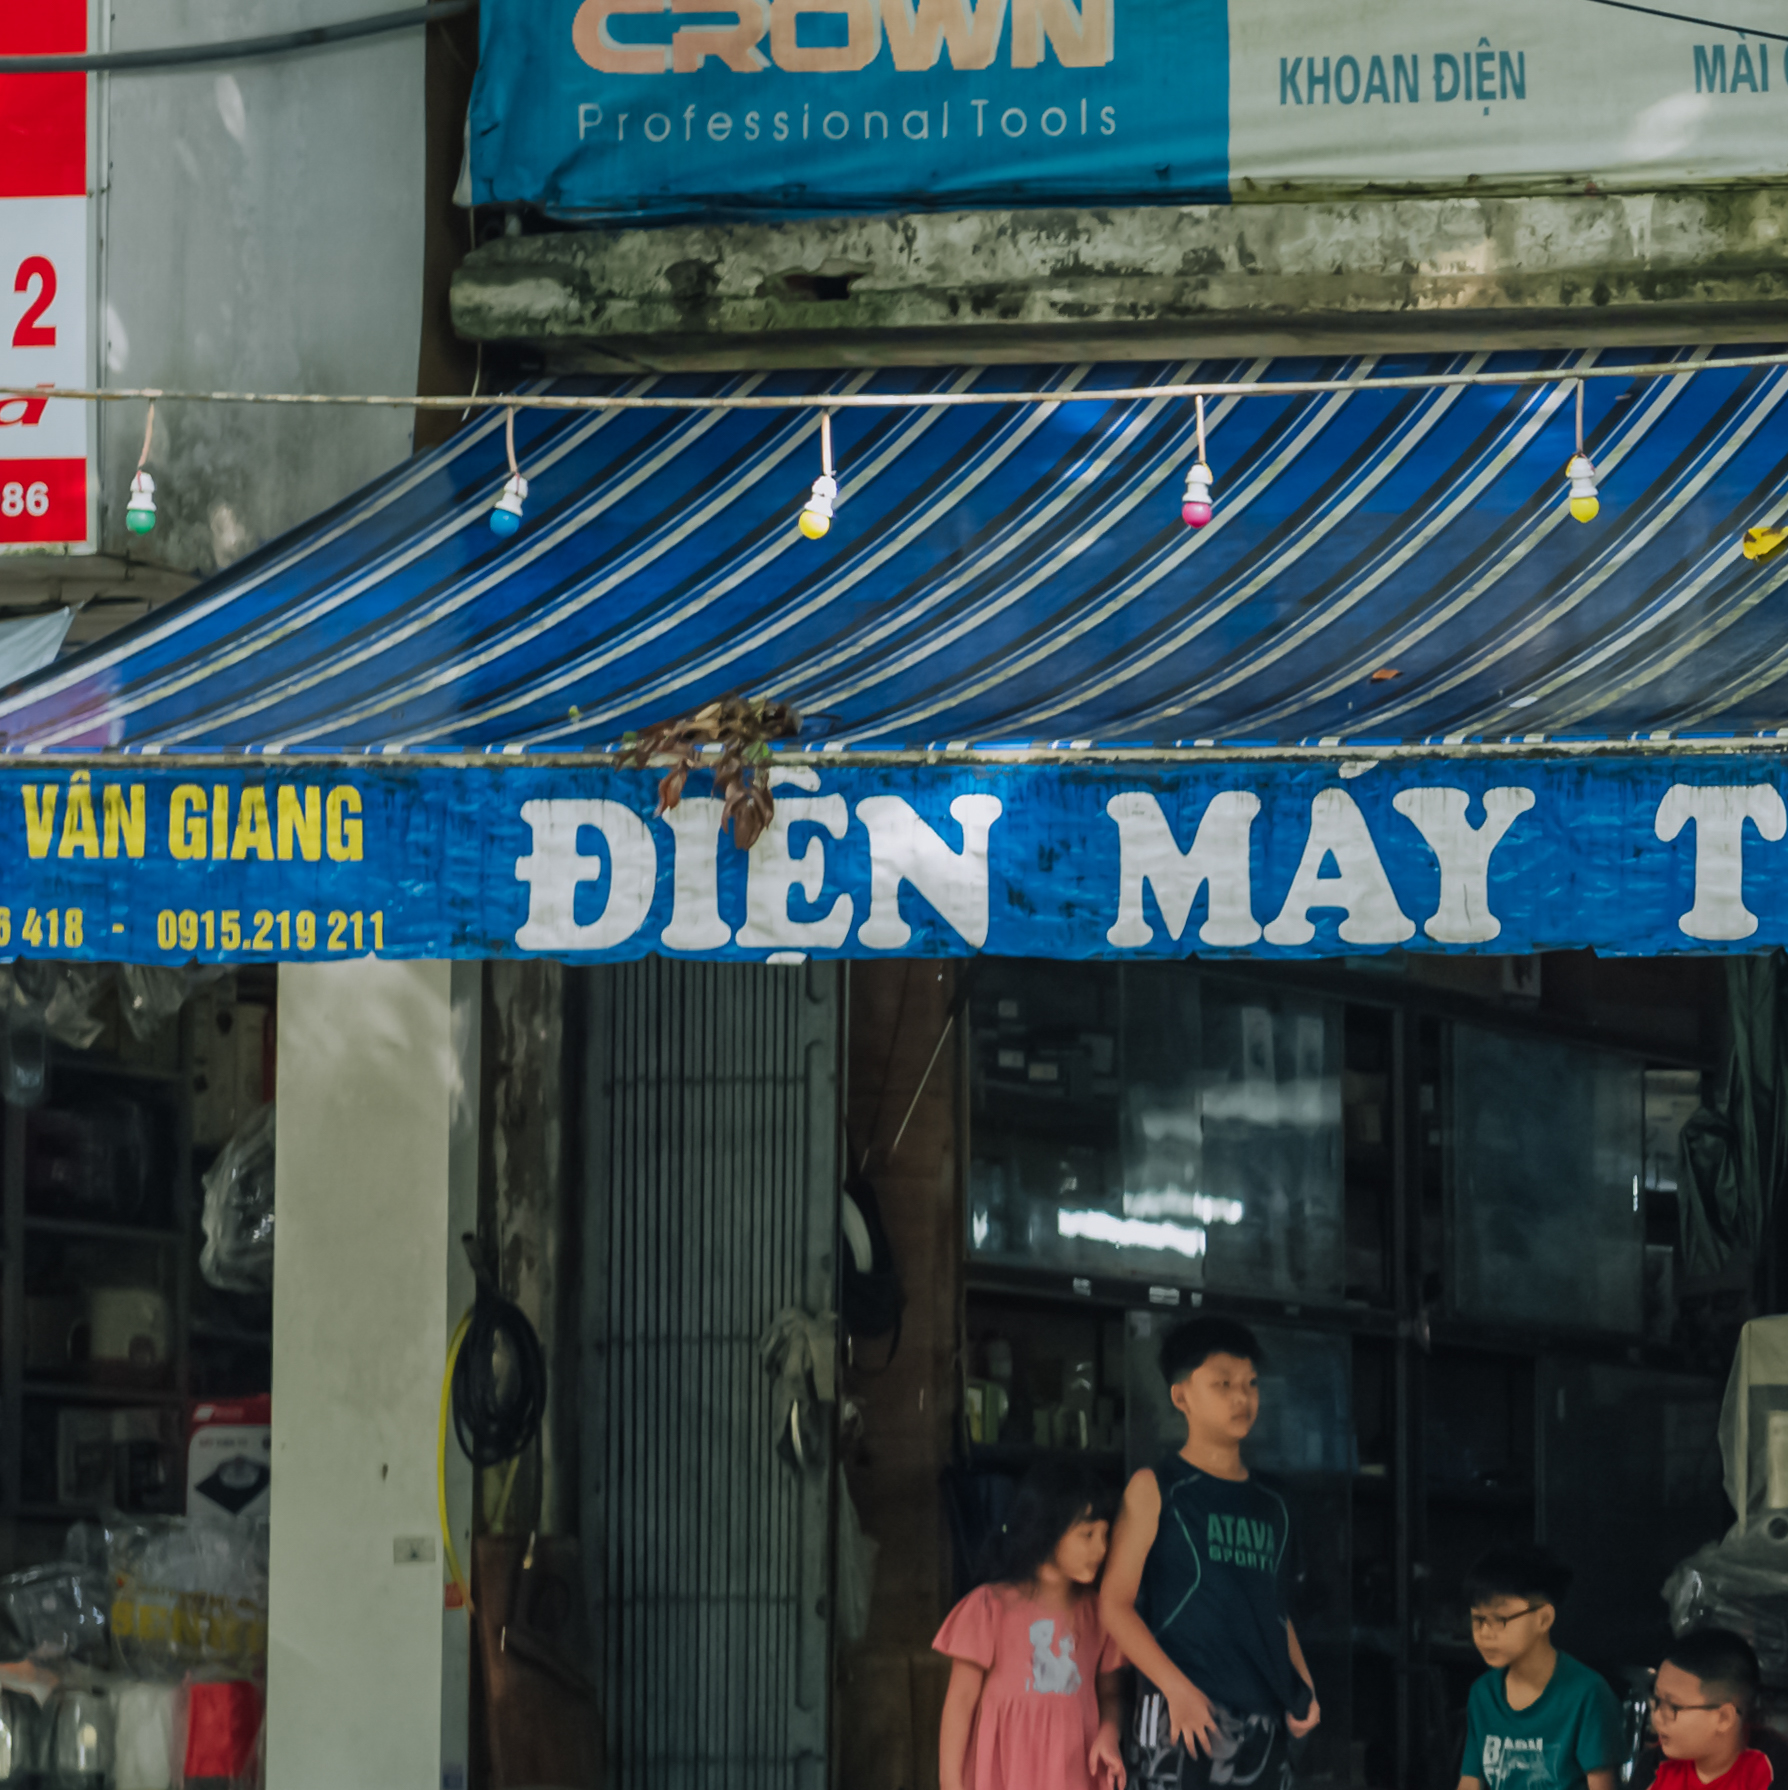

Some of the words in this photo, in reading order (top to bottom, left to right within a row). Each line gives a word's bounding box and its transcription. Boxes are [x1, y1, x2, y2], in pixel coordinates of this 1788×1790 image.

[572, 0, 1114, 73] CROWN
[1693, 33, 1769, 94] MÀI
[1279, 53, 1419, 105] KHOAN
[1433, 37, 1526, 117] ĐIỆN
[577, 100, 950, 142] Professional
[971, 98, 1116, 138] Tools
[12, 254, 57, 348] 2
[1, 481, 49, 517] 86
[21, 769, 146, 860] VÂN
[168, 784, 364, 861] GIANG
[515, 766, 1002, 967] ĐIỆN
[1106, 760, 1537, 948] MÁY
[22, 907, 84, 947] 418
[157, 909, 317, 951] 0915.219
[327, 910, 385, 951] 211
